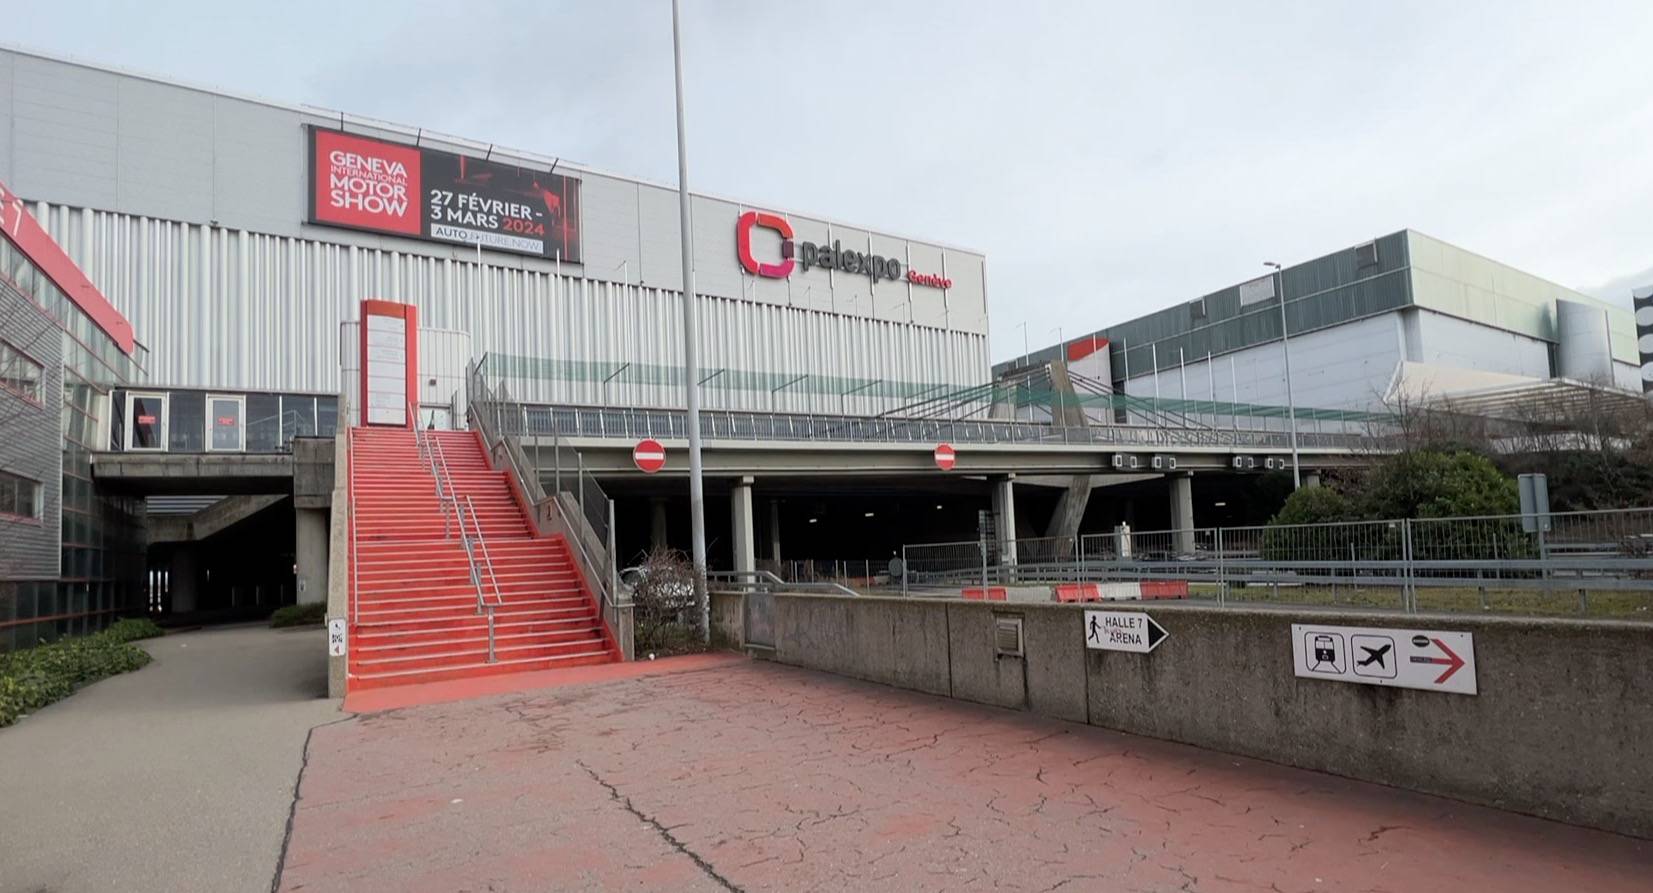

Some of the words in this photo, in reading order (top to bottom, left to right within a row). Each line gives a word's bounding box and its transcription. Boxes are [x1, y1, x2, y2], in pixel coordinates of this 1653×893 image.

[330, 150, 407, 178] GENEVA
[330, 165, 407, 186] INTERNATIONAL
[330, 173, 408, 201] MOTOR
[330, 189, 408, 218] SHOW
[430, 189, 453, 206] 27
[458, 192, 532, 220] FÉVRIER
[430, 205, 442, 220] 3
[447, 207, 499, 229] MARS
[503, 217, 545, 235] 2024
[435, 226, 468, 240] AUTO
[802, 239, 901, 283] palexpo
[907, 269, 952, 289] Genève
[1105, 616, 1135, 629] HALLE
[1138, 618, 1143, 629] 7
[1109, 632, 1142, 645] ARENA
